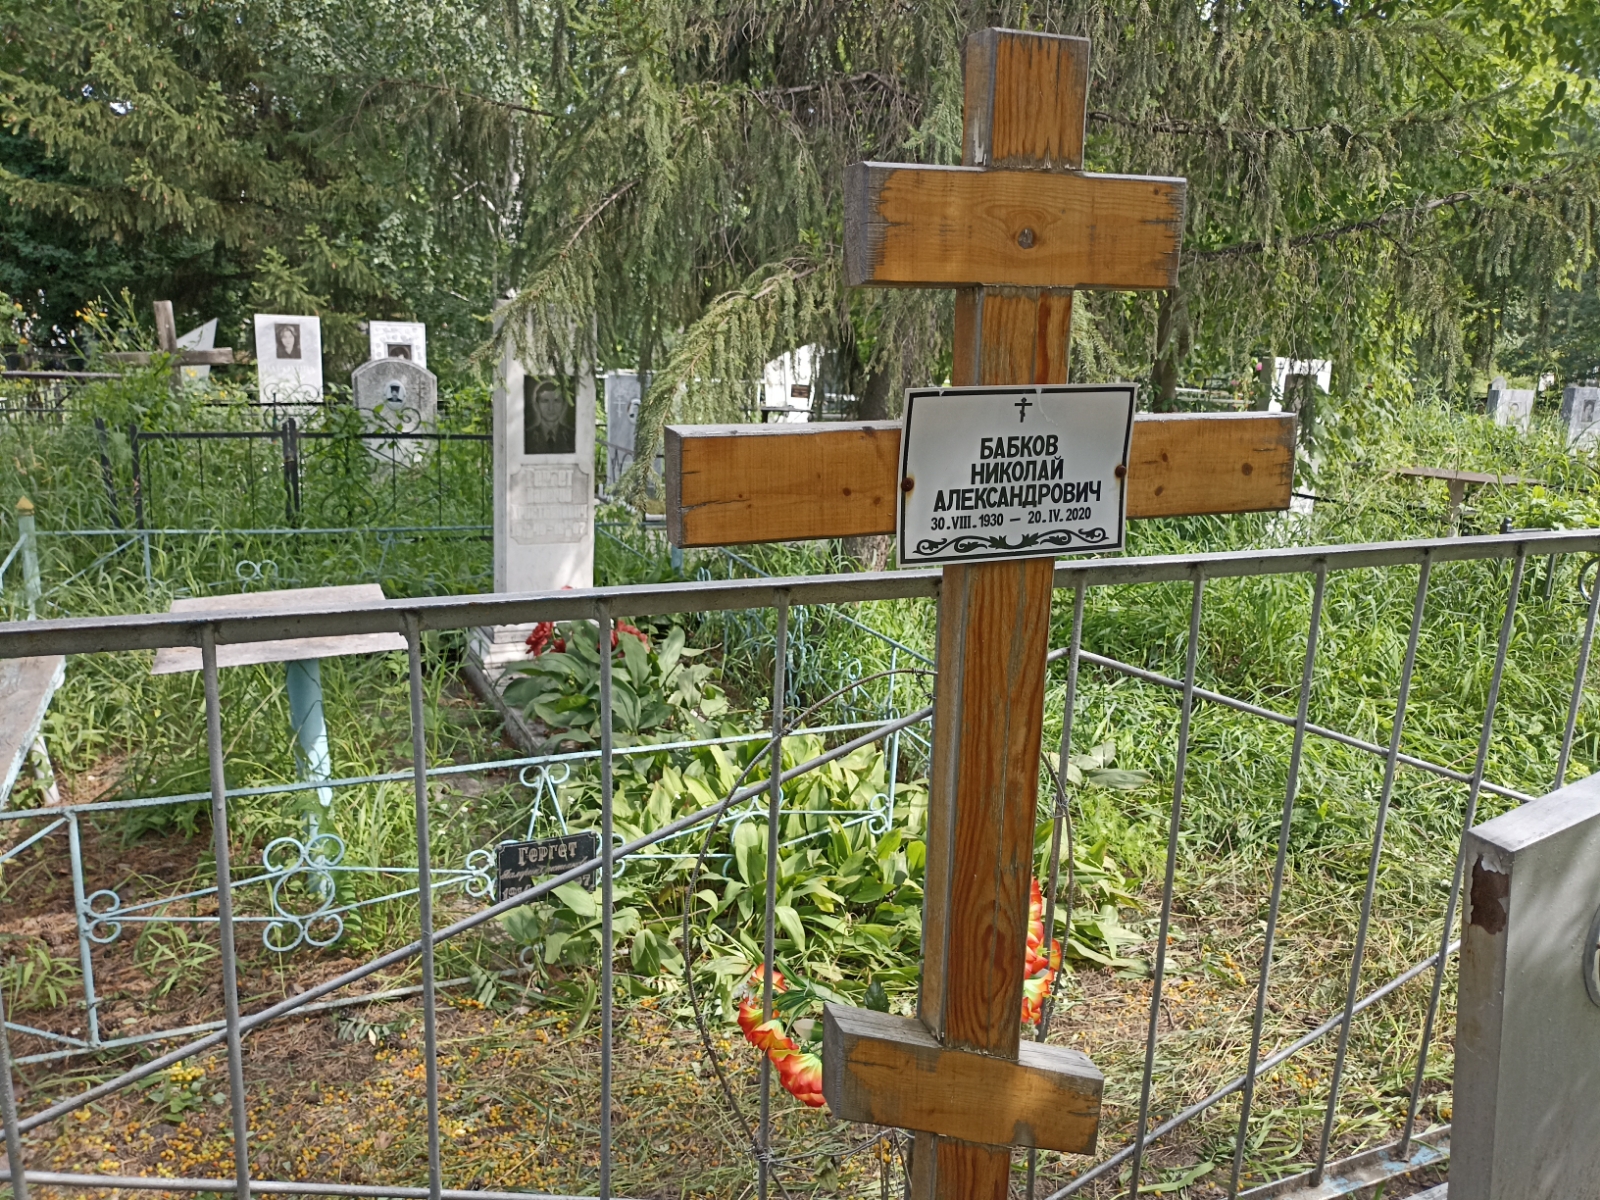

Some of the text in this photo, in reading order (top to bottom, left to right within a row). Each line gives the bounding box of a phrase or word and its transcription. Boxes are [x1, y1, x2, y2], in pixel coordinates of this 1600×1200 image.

[979, 434, 1059, 460] БАБКОВ
[970, 456, 1064, 485] НИКОЛАЙ
[933, 480, 1102, 512] АЛЕКСАНДРОВИЧ
[930, 513, 1004, 530] 30.VIII.1930
[1027, 507, 1091, 524] 20.IV.2020
